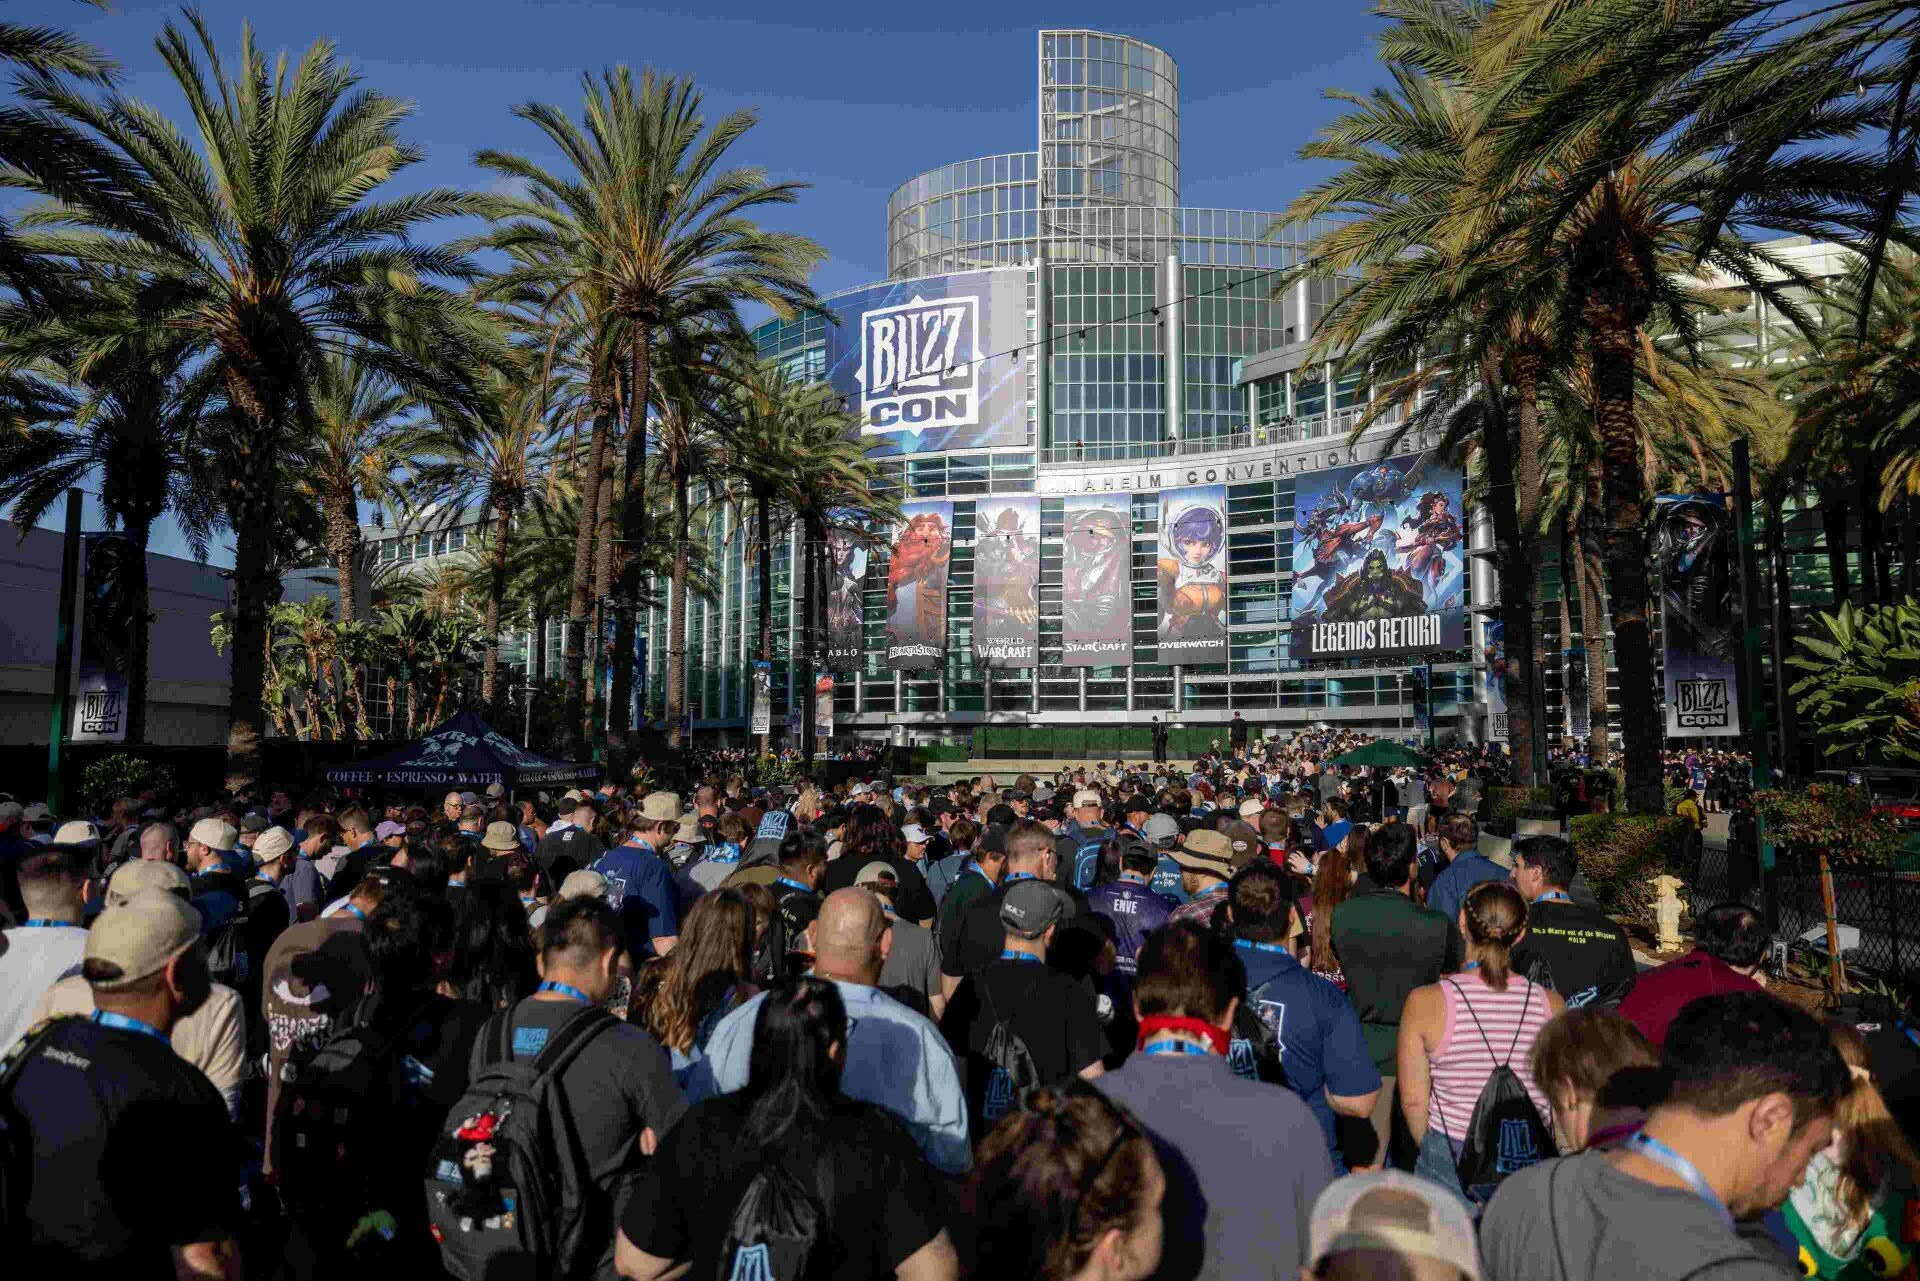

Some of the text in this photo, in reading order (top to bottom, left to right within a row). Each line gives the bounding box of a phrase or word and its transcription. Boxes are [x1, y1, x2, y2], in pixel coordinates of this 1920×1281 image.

[870, 307, 968, 394] BLIZZ
[870, 394, 967, 427] CON
[1187, 448, 1358, 484] CONVENTION
[986, 637, 1024, 645] WORLD
[1312, 614, 1440, 652] LEGENDS RETURN
[1158, 639, 1224, 650] OVERWATCH
[86, 694, 117, 719] BLIZZ
[1680, 682, 1723, 712] BLIZZ
[84, 722, 116, 732] CON
[1681, 715, 1724, 726] CON
[326, 771, 503, 784] COFFEE ESPRESSO WATER
[1113, 899, 1138, 914] ENVE
